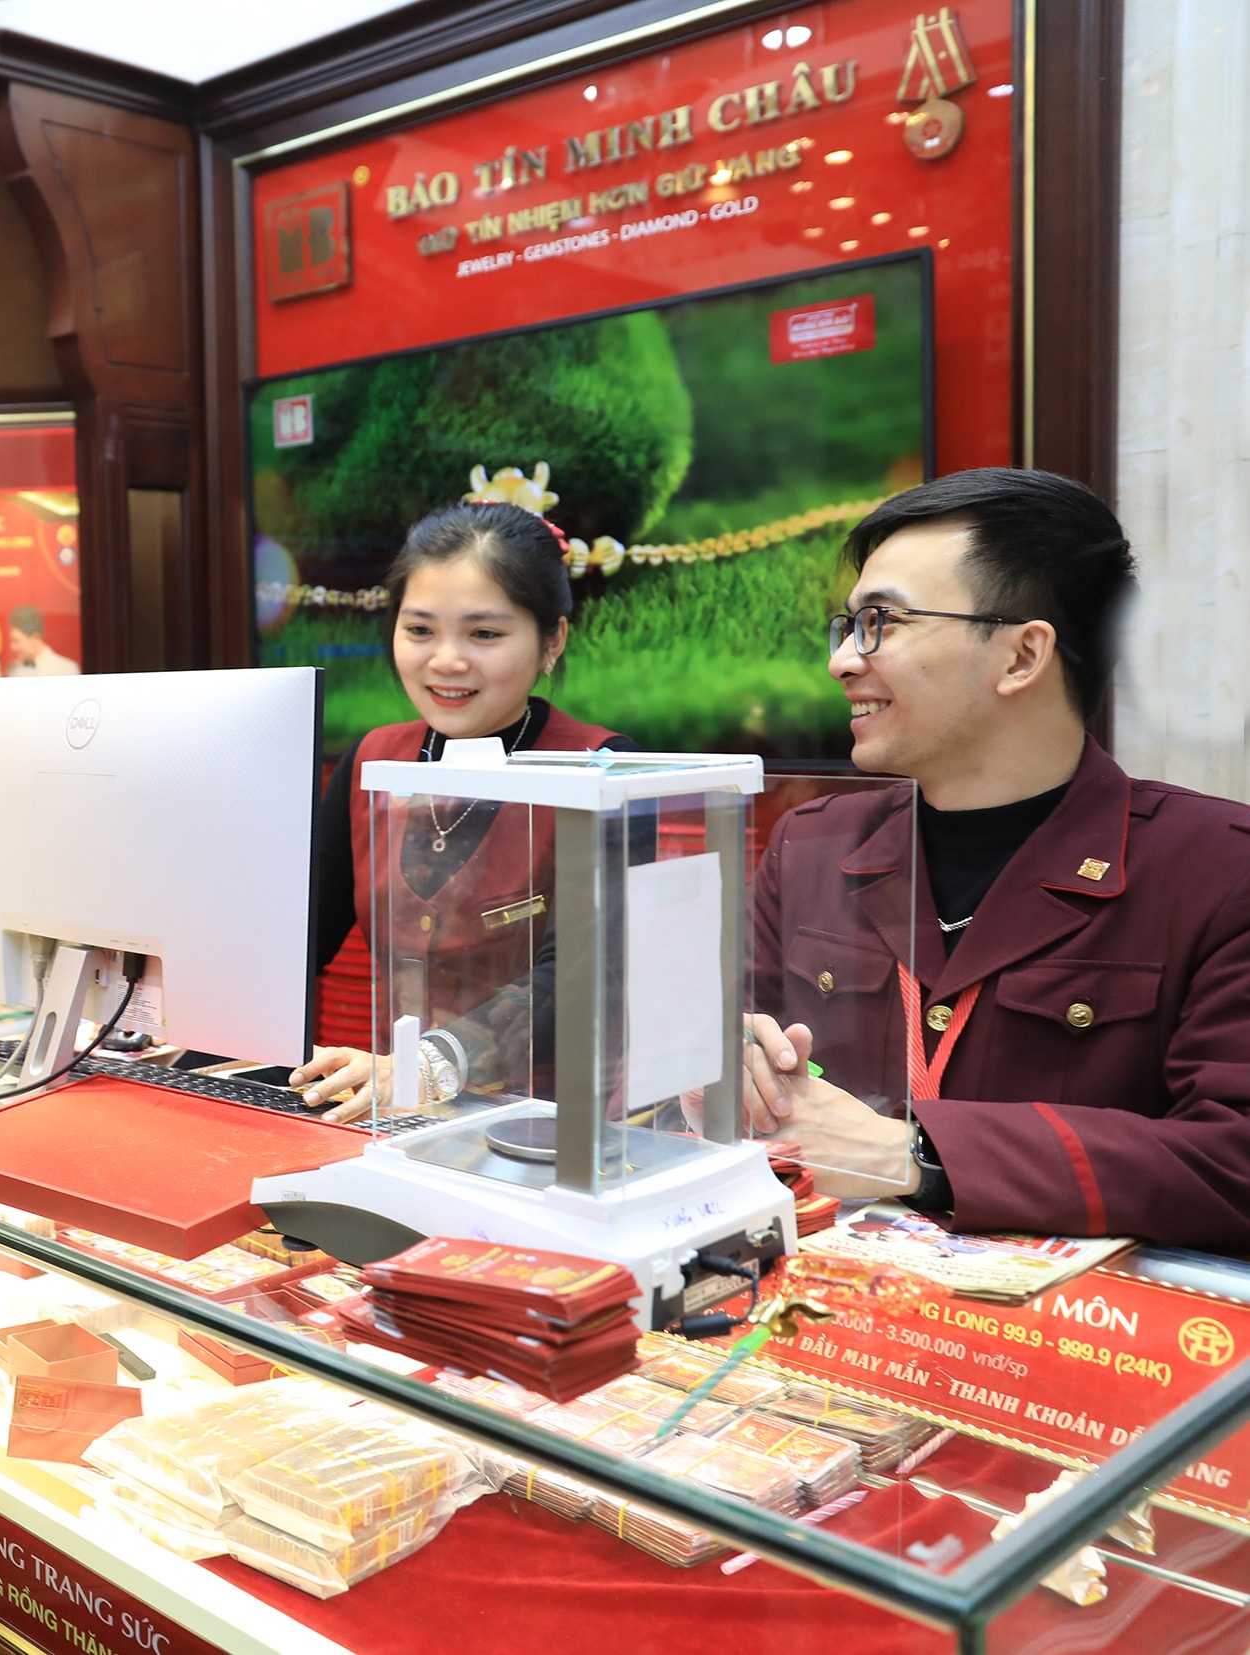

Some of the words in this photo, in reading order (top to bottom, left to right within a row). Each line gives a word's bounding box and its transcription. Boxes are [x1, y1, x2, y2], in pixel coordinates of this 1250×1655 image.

[385, 171, 459, 219] BẢO
[473, 146, 549, 194] TÍN
[564, 105, 694, 172] MINH
[707, 60, 857, 133] CHÂU
[456, 248, 515, 278] JEWELRY
[523, 228, 610, 263] GEMSTONES
[620, 208, 698, 242] DIAMOND
[708, 195, 759, 221] GOLD
[465, 213, 502, 244] TÍN
[508, 196, 582, 235] NHIỆM
[885, 1324, 966, 1361] 3.500.000
[972, 1349, 1029, 1380] vnđ/sp
[943, 1306, 1000, 1337] LONG
[1002, 1322, 1043, 1348] 99.9
[1057, 1337, 1112, 1367] 999.9
[1114, 1351, 1172, 1388] (24K)
[1051, 1293, 1139, 1337] MÔN
[799, 1332, 839, 1360] ĐẦU
[841, 1348, 883, 1373] MAY
[884, 1359, 931, 1388] MẮN
[949, 1379, 1021, 1413] THANH
[1025, 1410, 1105, 1440] KHOẢN
[8, 1583, 58, 1633] RỒNG
[61, 1617, 119, 1655] THĂN
[31, 1554, 114, 1626] TRANG
[121, 1612, 170, 1655] SỨC
